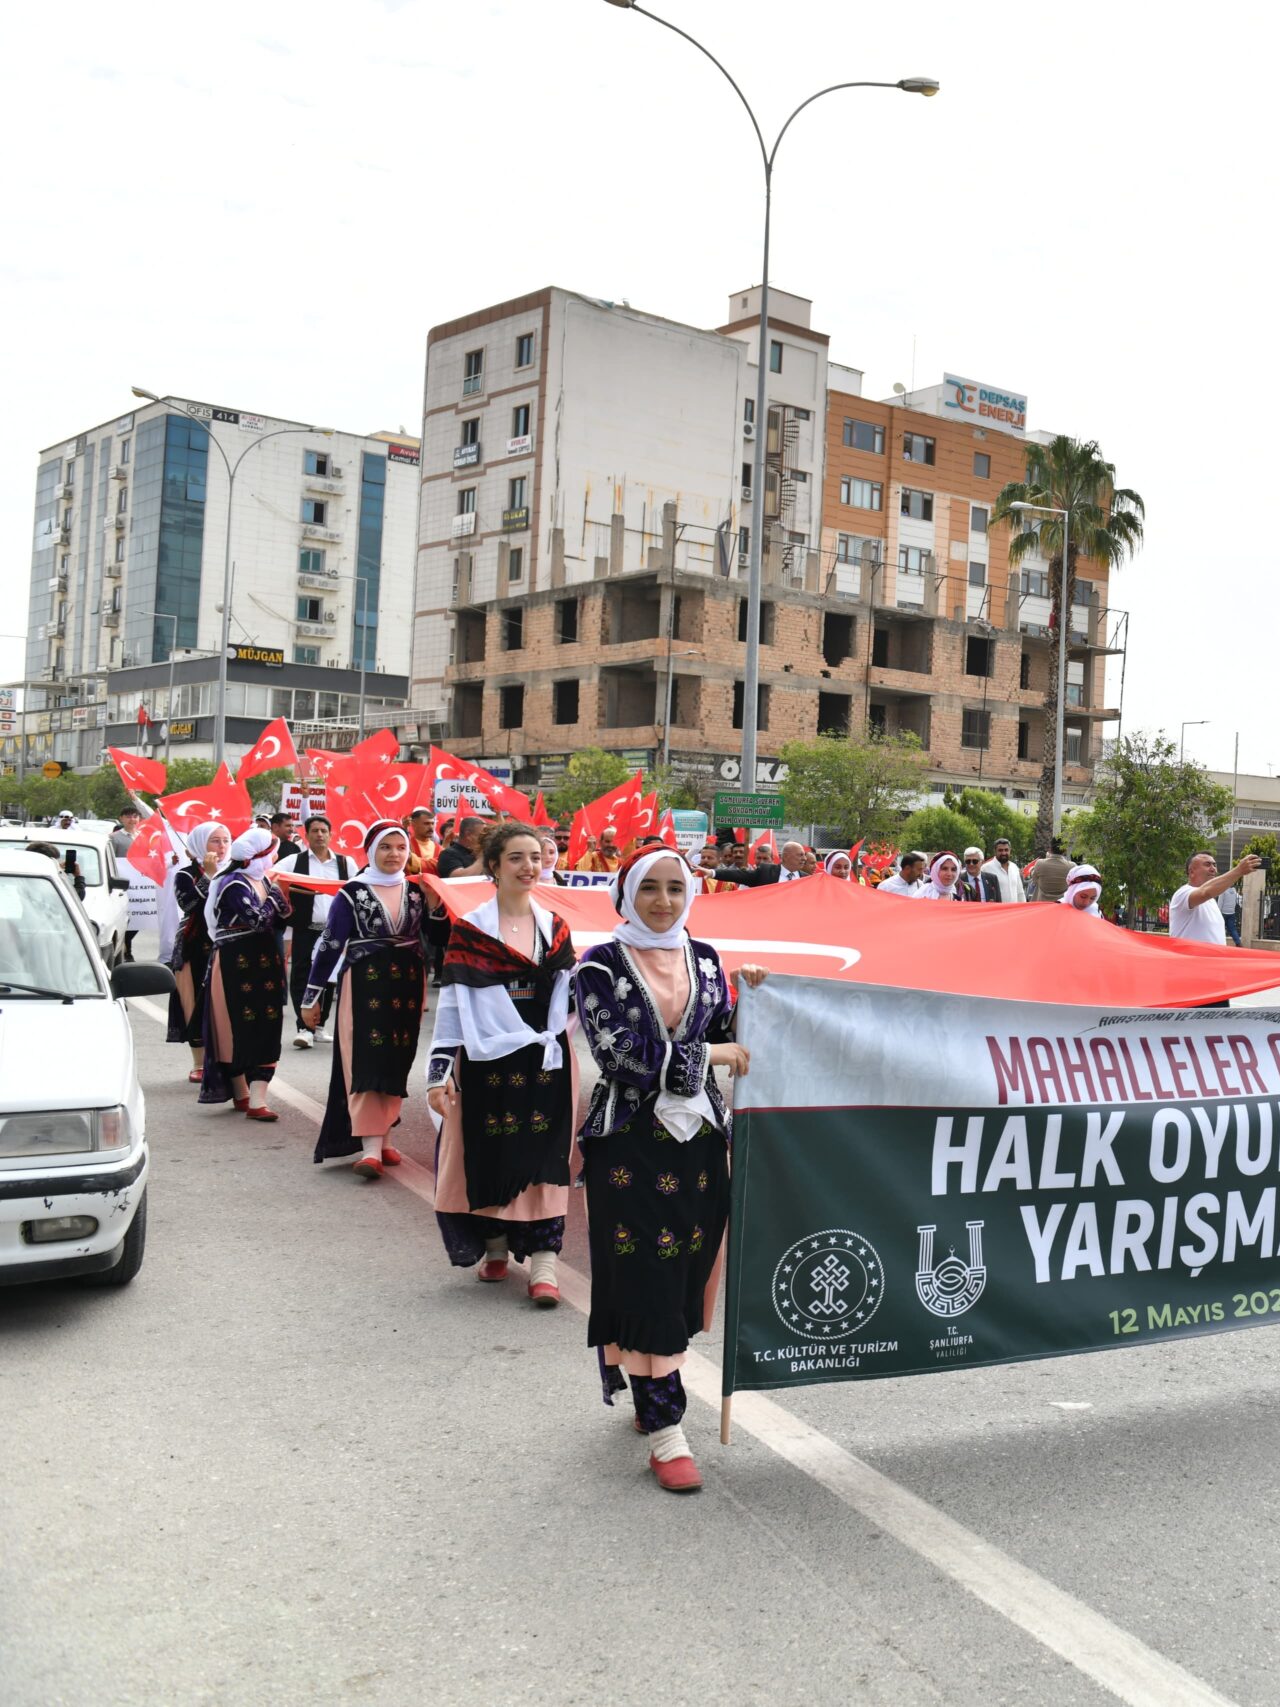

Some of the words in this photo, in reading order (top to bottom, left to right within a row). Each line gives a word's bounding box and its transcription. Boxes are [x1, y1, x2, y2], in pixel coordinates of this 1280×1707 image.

[237, 648, 282, 663] MÜJGAN
[720, 757, 789, 783] ÖKA
[450, 783, 480, 793] SİVER
[1175, 1011, 1191, 1021] VE
[986, 1033, 1267, 1106] MAHALLELER
[931, 1110, 1127, 1195] HALK
[1109, 1308, 1138, 1334] 12
[947, 1326, 959, 1335] T.C.
[753, 1351, 775, 1362] T.C.
[777, 1344, 826, 1360] KÜLTÜR
[830, 1344, 847, 1355] VE
[850, 1340, 898, 1354] TURİZM
[929, 1335, 973, 1350] ŞANLIURFA
[790, 1356, 860, 1373] BAKANLIĞI
